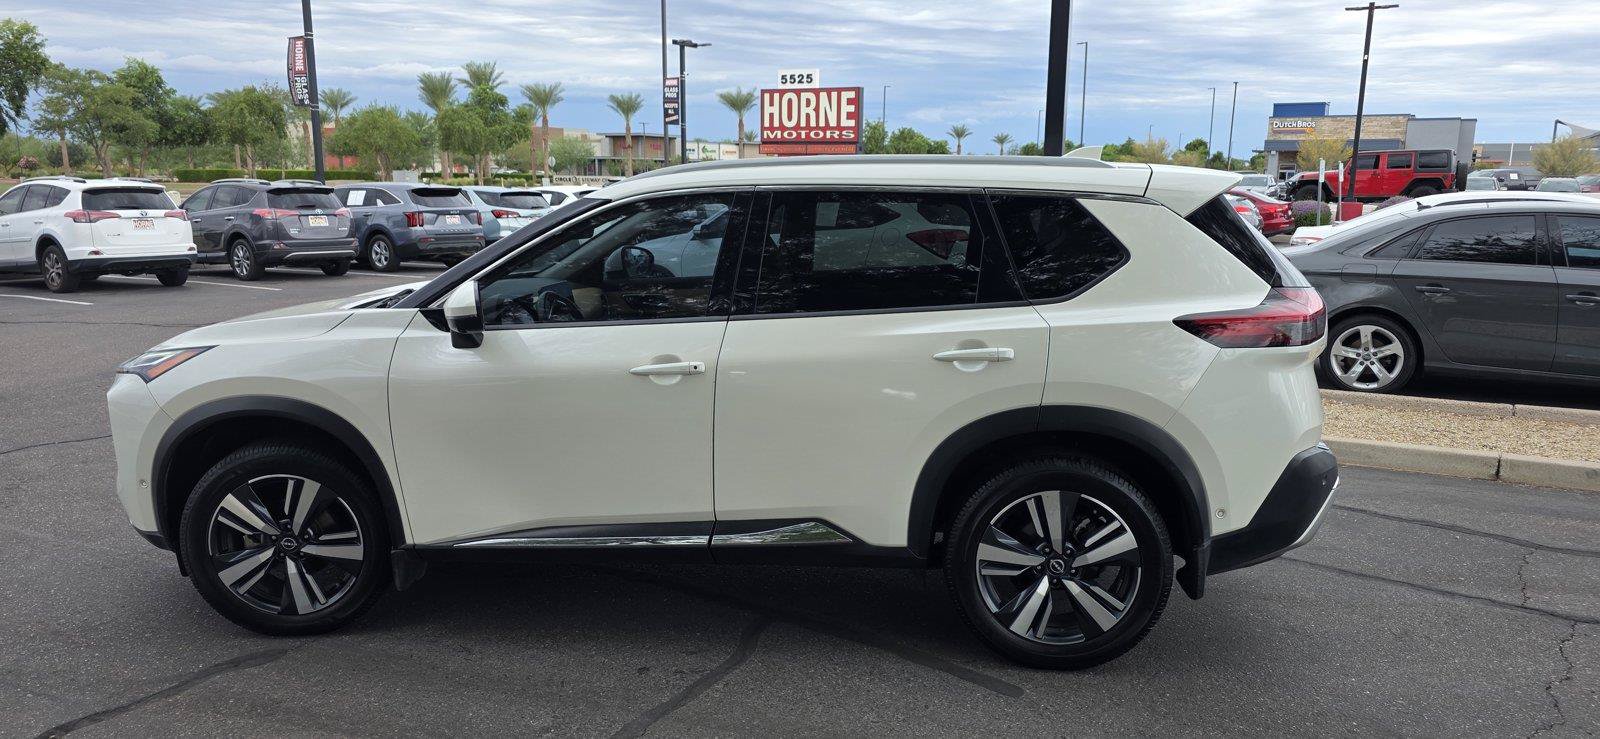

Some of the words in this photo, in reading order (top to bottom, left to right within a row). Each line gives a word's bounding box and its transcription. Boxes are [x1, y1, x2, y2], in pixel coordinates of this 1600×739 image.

[295, 40, 304, 71] HORNE
[294, 77, 304, 100] PROS
[301, 77, 310, 105] GLASS
[780, 73, 813, 84] 5525
[763, 91, 856, 128] HORNE
[763, 130, 855, 139] MOTORS
